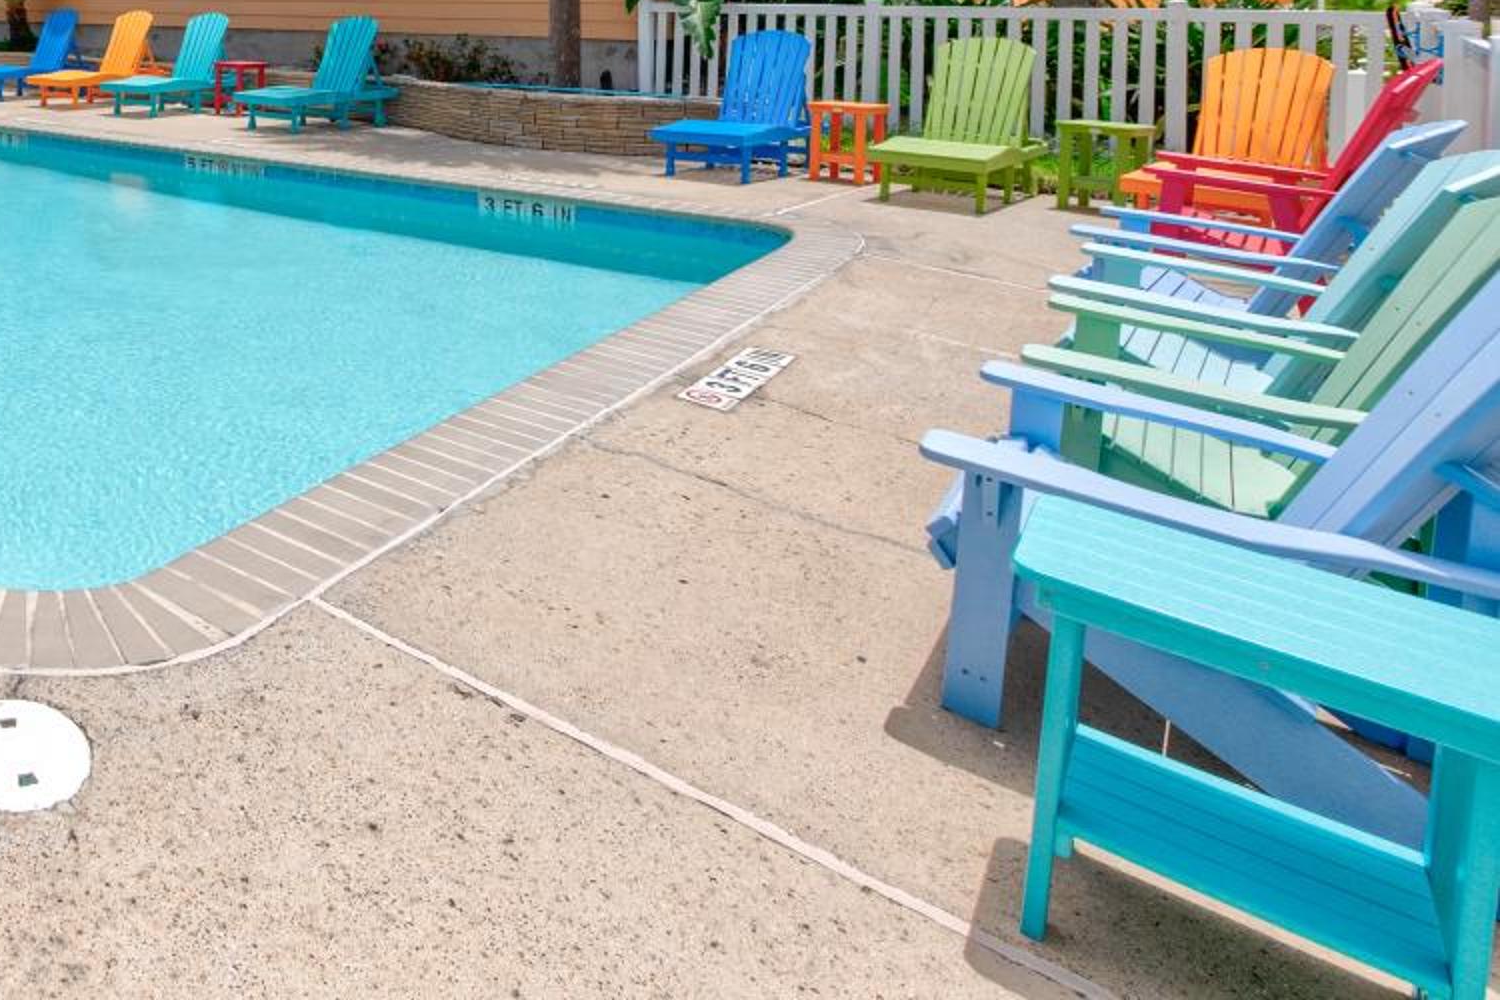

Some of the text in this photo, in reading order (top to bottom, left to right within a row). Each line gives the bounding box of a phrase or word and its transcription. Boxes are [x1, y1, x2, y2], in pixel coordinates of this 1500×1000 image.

[484, 196, 571, 222] 3 FT 6 IN
[735, 360, 771, 373] 6
[716, 368, 760, 388] FT
[705, 381, 742, 393] 3
